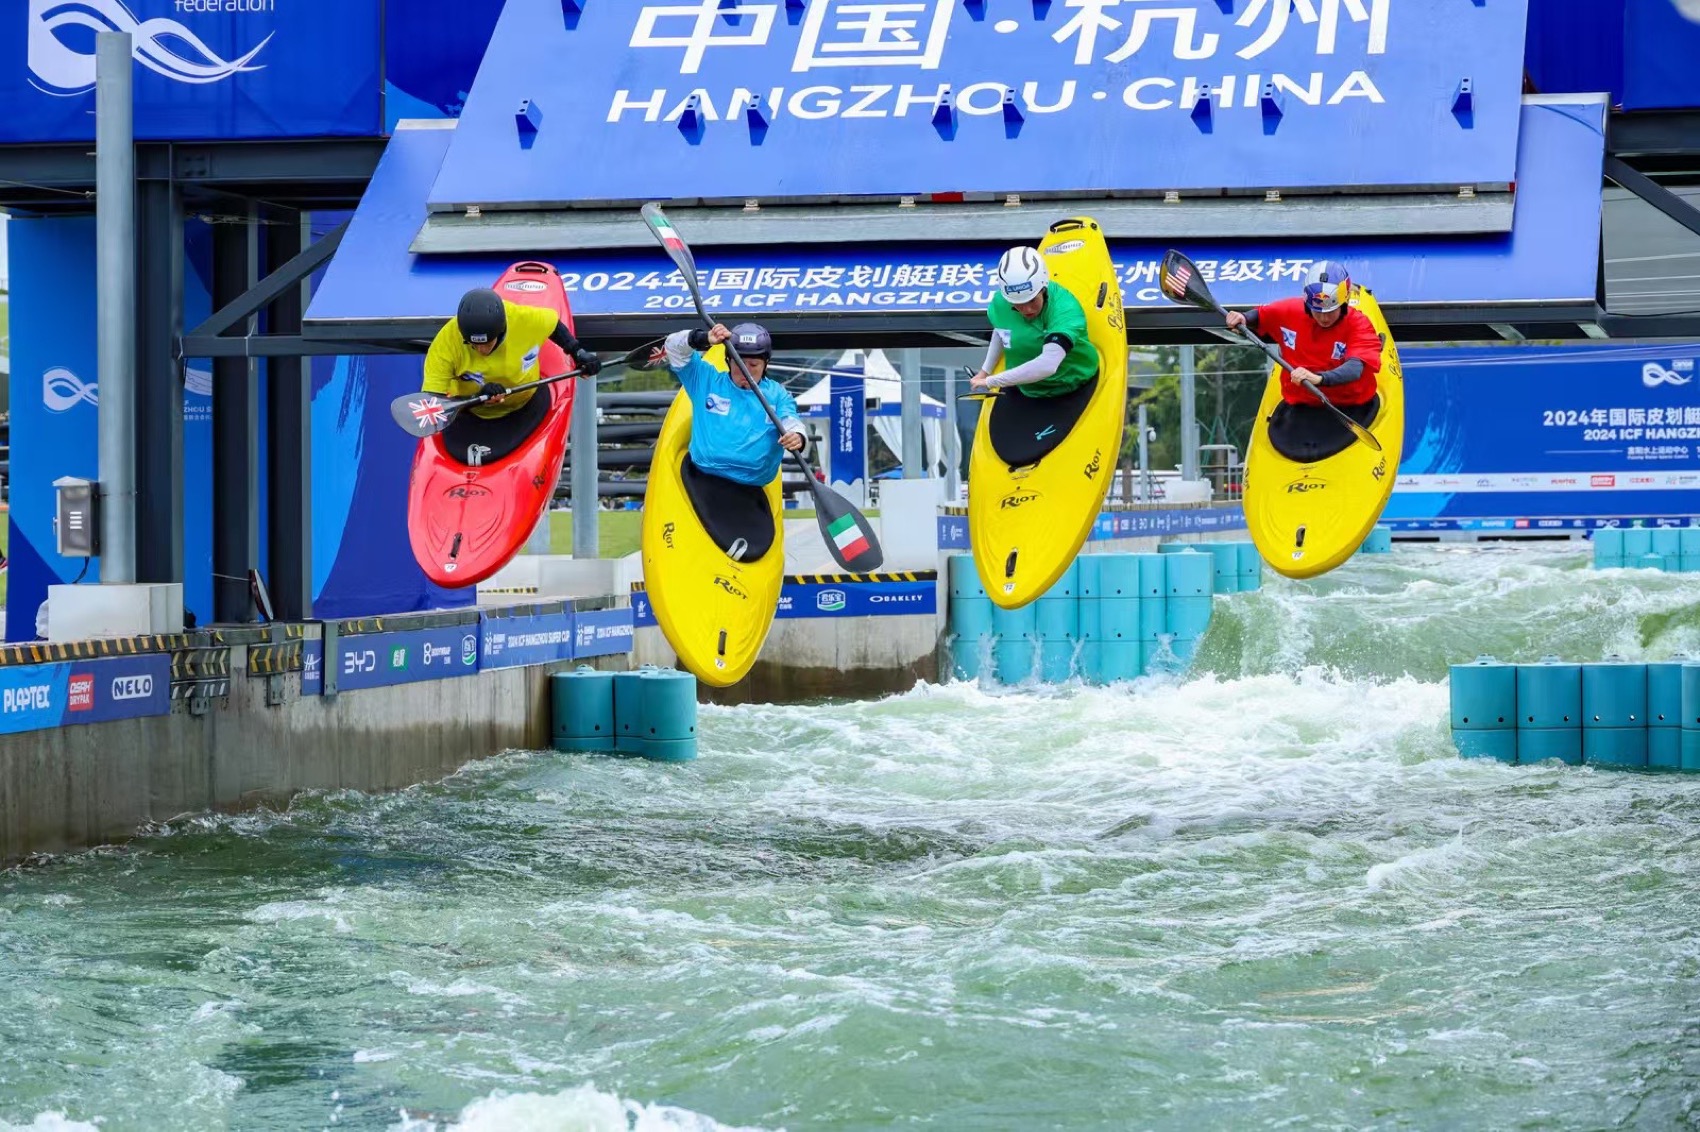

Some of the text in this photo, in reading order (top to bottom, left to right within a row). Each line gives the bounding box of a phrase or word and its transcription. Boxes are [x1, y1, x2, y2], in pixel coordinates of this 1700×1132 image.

[731, 293, 793, 308] ICF
[795, 290, 996, 307] HANGZHOU
[1584, 429, 1617, 441] 2024
[1620, 428, 1642, 440] ICF
[114, 679, 151, 697] NELO
